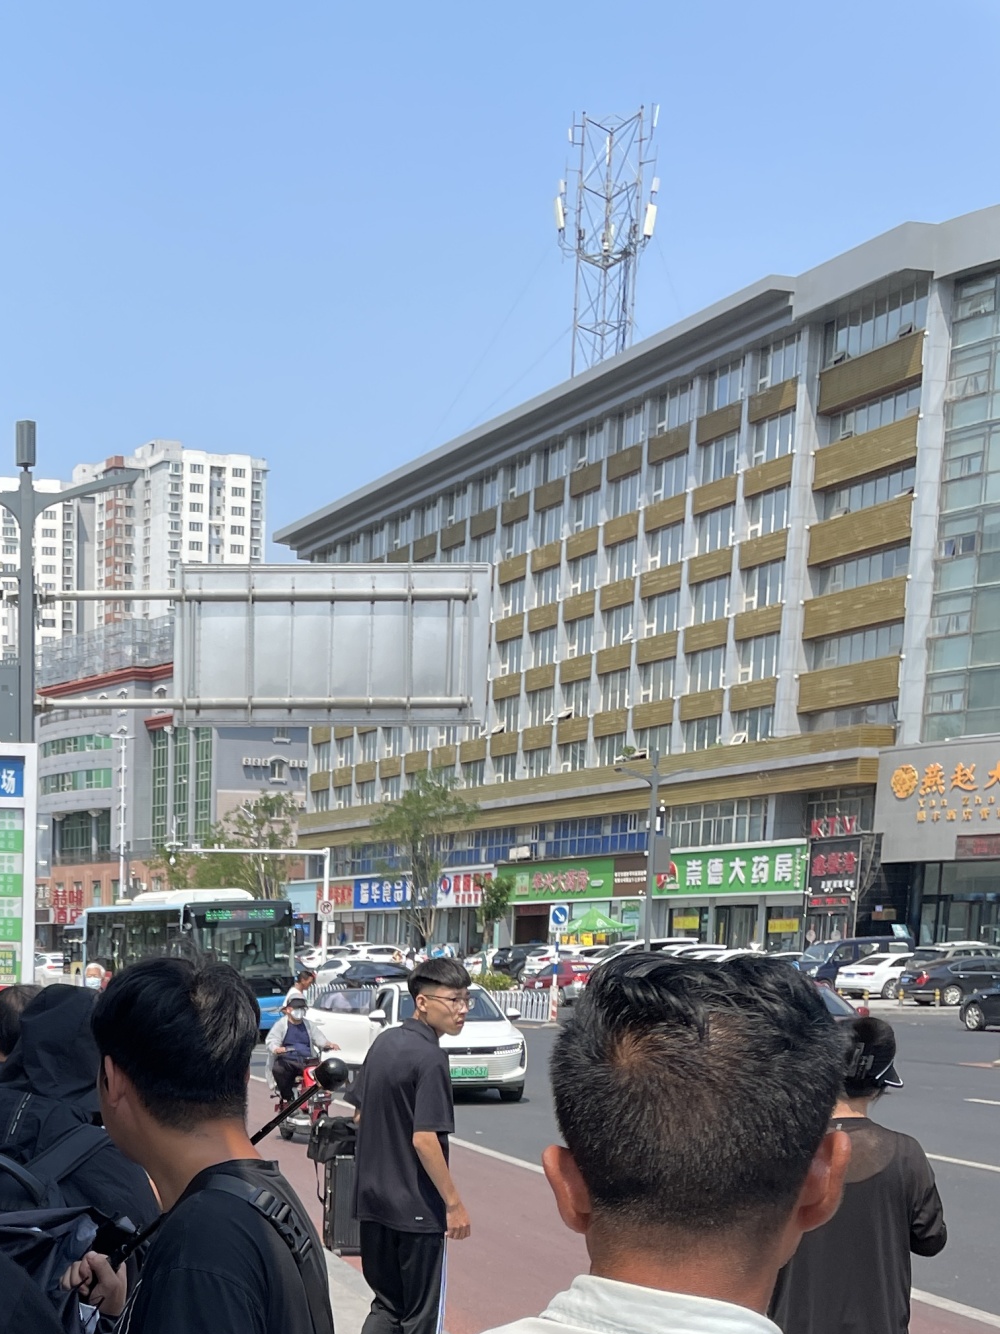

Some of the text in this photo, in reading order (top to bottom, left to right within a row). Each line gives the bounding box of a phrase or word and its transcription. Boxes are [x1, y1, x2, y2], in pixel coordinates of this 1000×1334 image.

[810, 815, 857, 838] KTV
[686, 853, 793, 886] 崇德大药房
